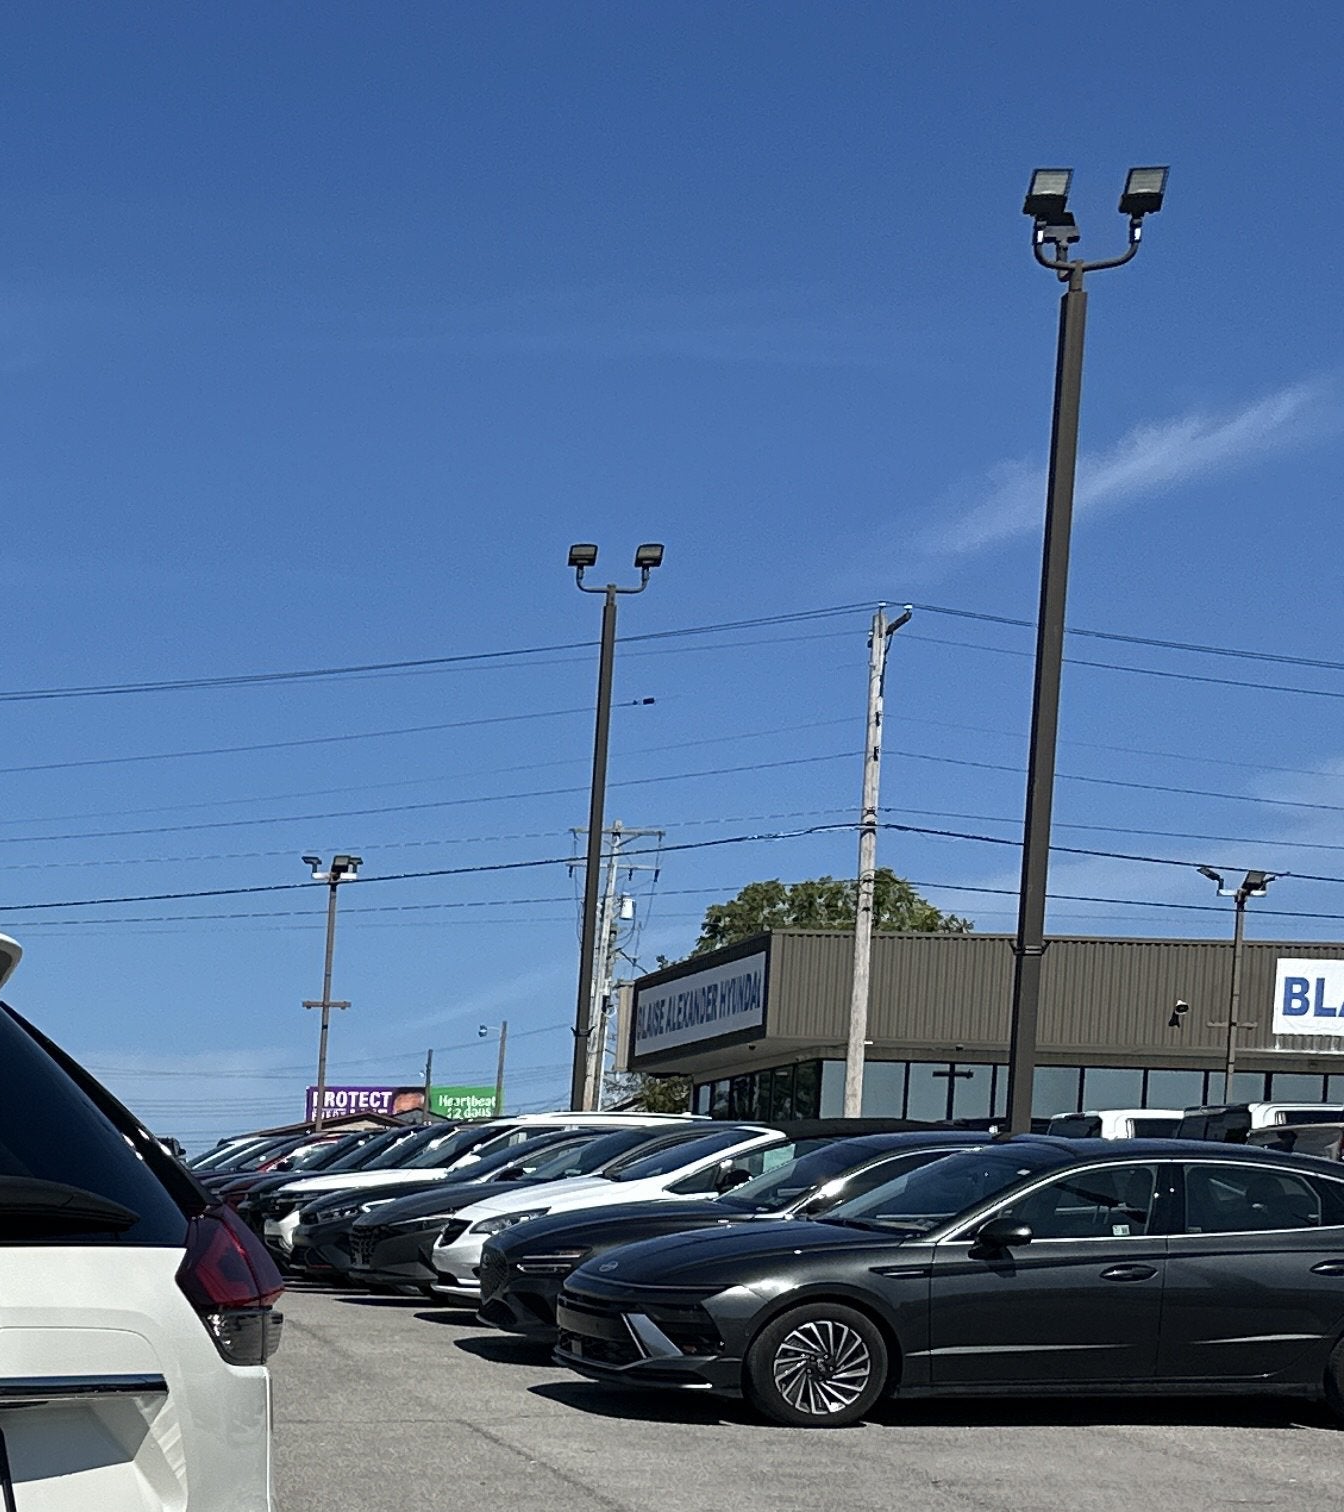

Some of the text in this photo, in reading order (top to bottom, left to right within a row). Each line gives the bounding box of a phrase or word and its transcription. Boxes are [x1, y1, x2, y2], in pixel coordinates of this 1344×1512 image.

[665, 984, 719, 1034] ALEXANDER
[719, 969, 762, 1019] HYUNDAI
[1282, 976, 1344, 1018] BL
